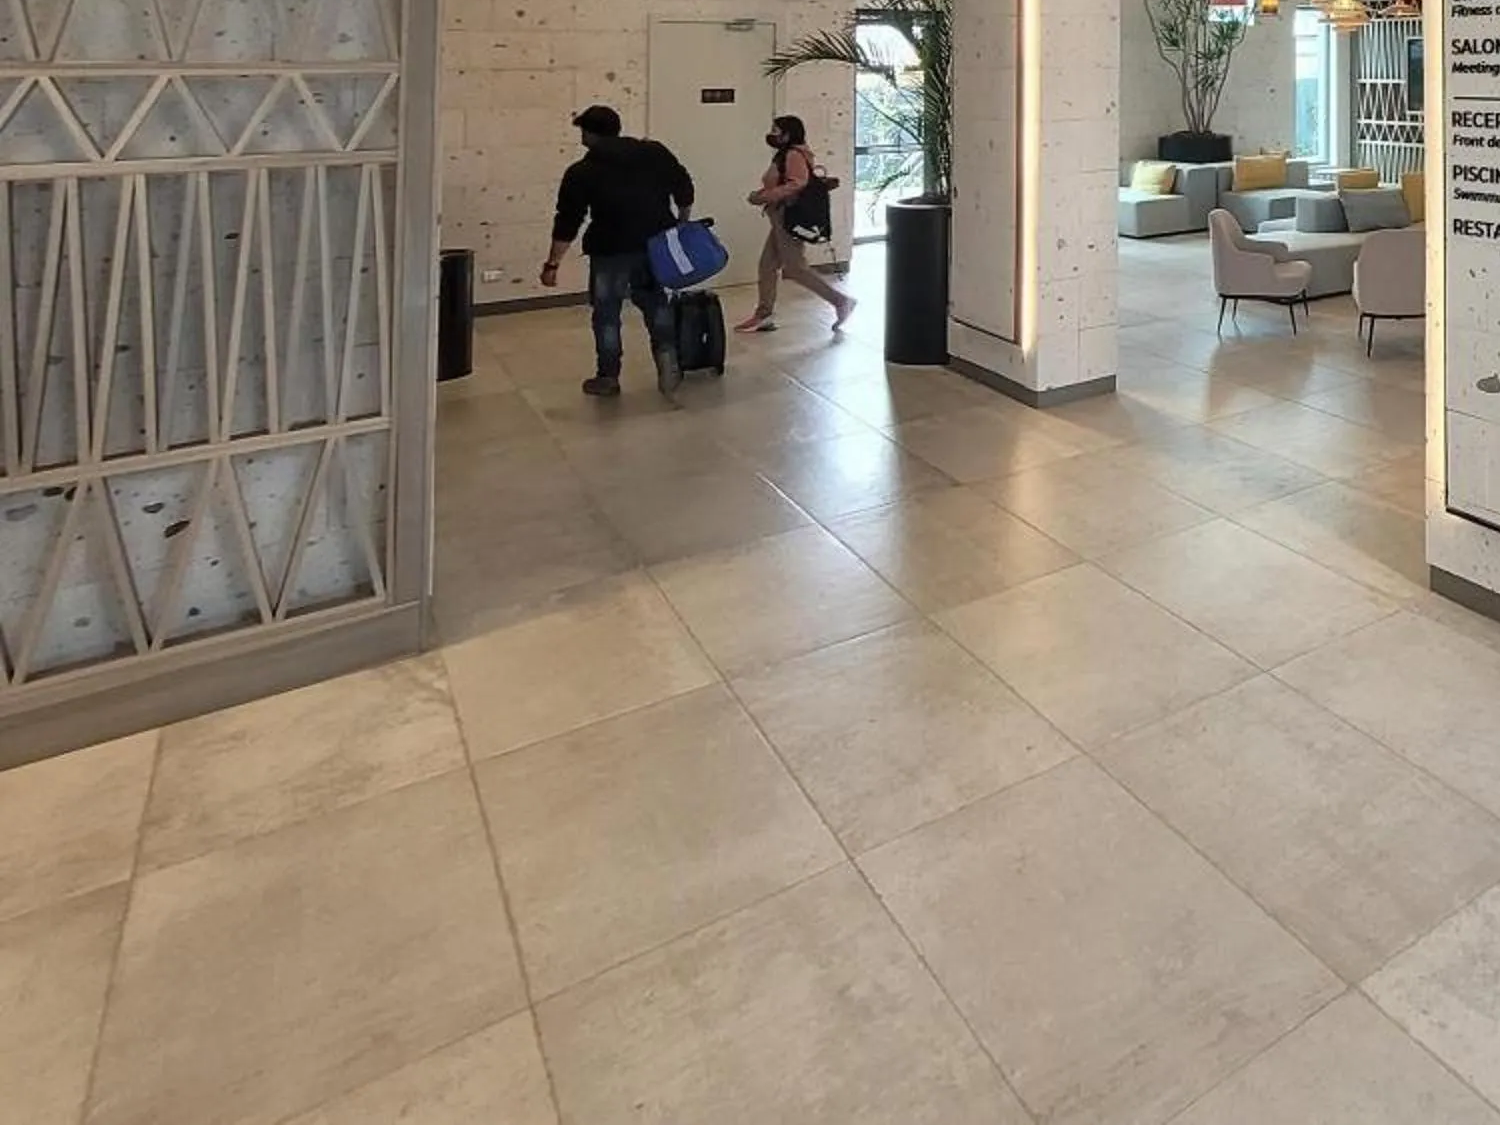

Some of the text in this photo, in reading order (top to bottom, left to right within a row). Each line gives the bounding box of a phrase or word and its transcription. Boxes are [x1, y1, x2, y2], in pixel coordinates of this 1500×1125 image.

[1451, 5, 1493, 18] Fitness
[1452, 60, 1500, 76] Meeting
[1452, 134, 1485, 147] Front
